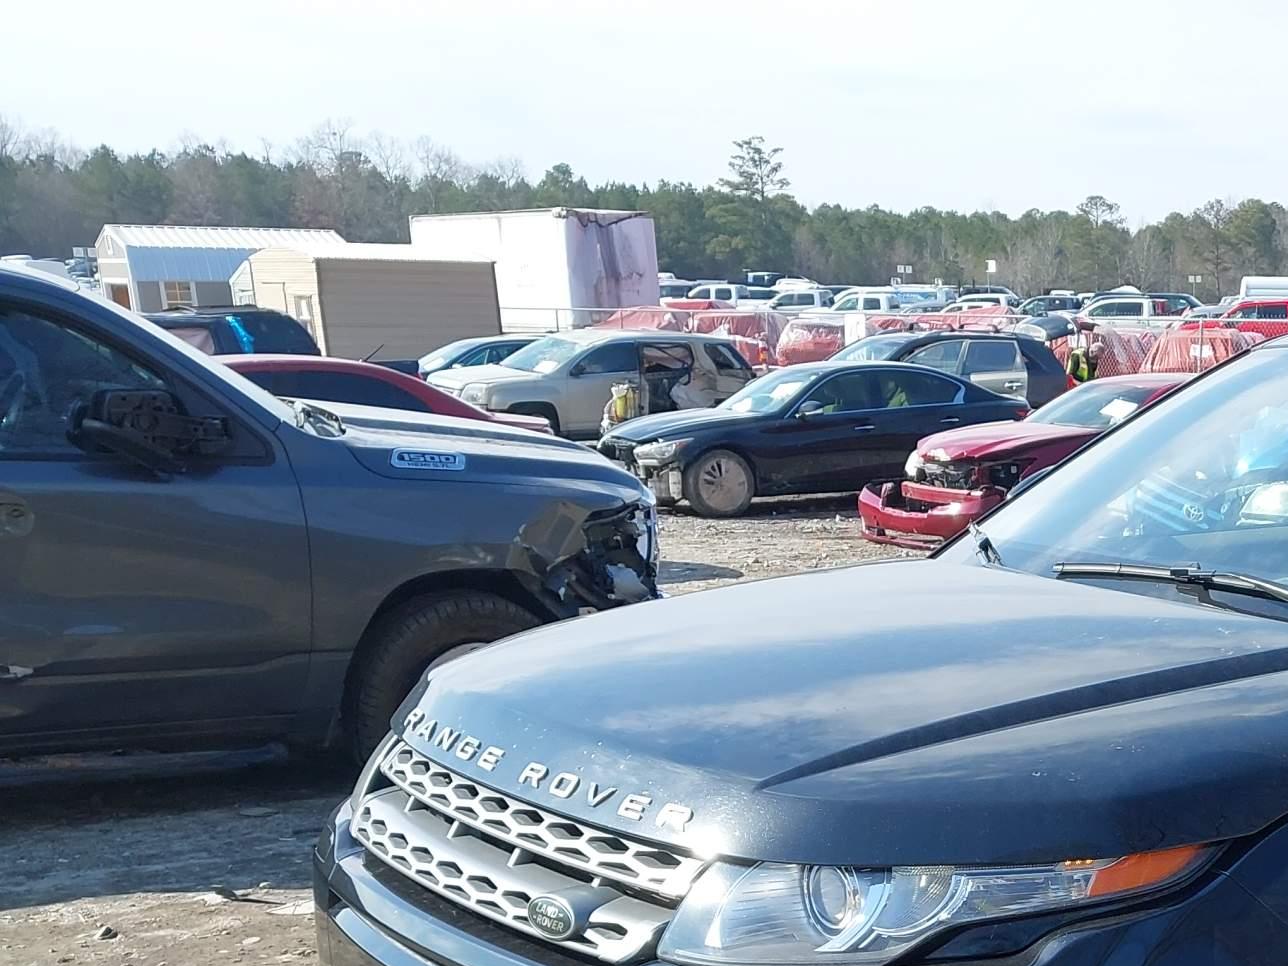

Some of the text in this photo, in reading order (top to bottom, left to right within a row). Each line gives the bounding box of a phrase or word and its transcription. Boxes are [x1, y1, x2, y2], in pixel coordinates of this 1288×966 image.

[400, 452, 456, 464] 1500
[403, 707, 694, 832] RANGE ROVER
[535, 902, 559, 919] LAND
[536, 914, 564, 932] ROVER
